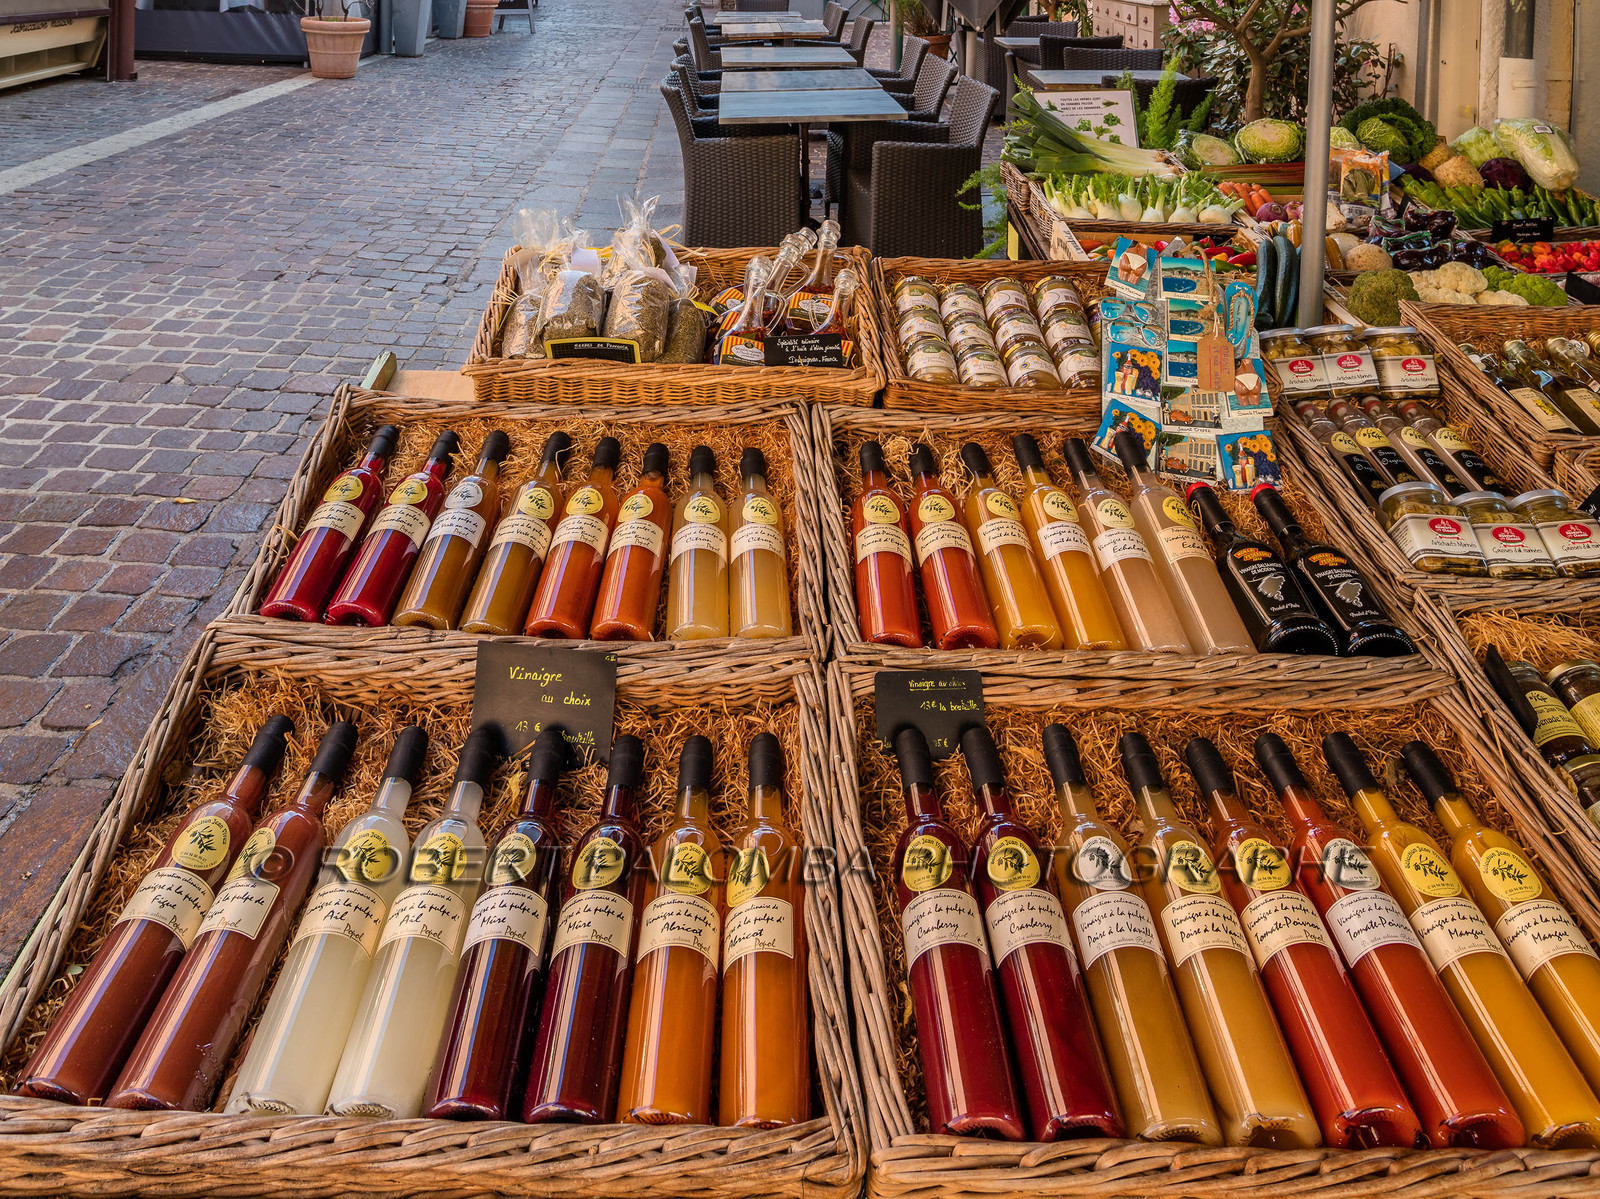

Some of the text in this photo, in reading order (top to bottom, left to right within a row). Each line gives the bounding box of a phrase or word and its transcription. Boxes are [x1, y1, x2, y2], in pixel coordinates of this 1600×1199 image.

[509, 666, 563, 687] Vinaigre
[908, 678, 936, 691] Vinaigre
[541, 691, 591, 706] au choix
[939, 702, 947, 711] la
[917, 919, 960, 939] Cranberry
[1009, 917, 1053, 934] Cranberry
[1417, 917, 1449, 939] Vinaigre
[1448, 928, 1486, 940] Mangue
[1531, 930, 1569, 944] Mangue
